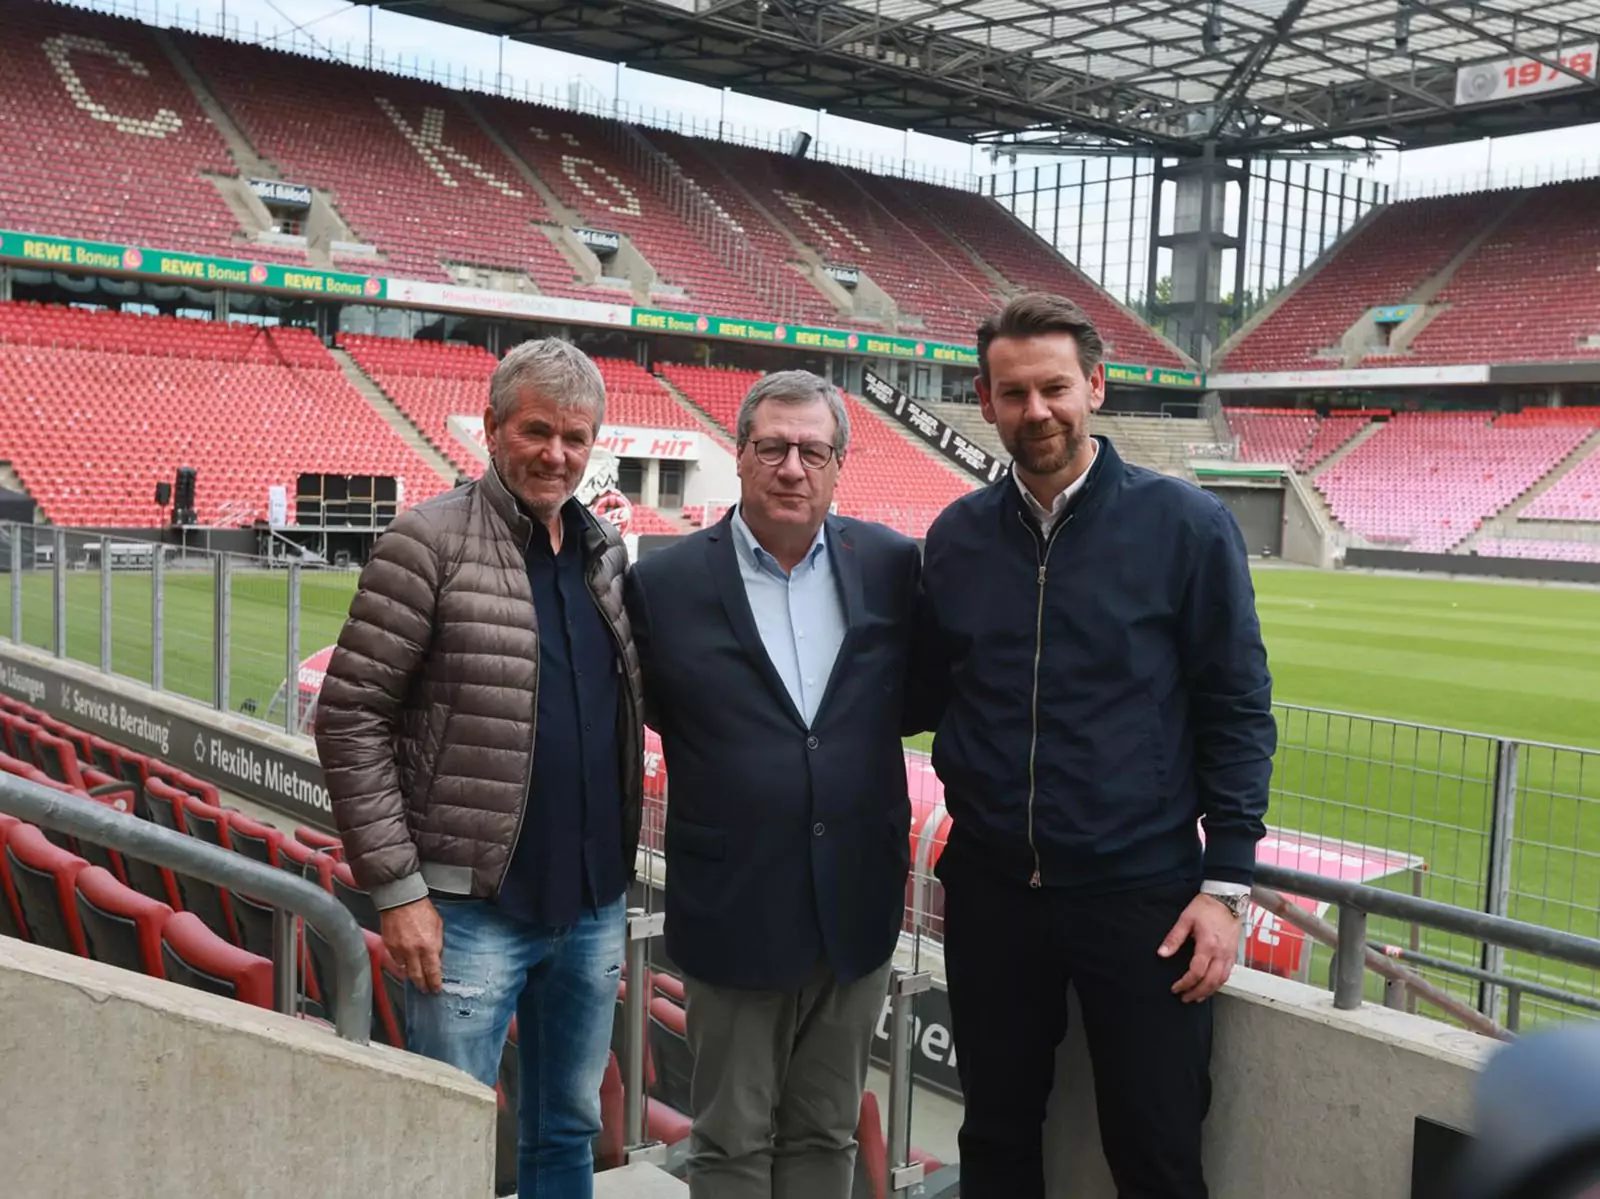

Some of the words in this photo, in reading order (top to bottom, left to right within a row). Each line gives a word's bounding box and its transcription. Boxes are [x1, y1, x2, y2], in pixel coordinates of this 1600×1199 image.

[24, 240, 72, 262] REWE
[76, 247, 119, 269] Bonus
[161, 258, 204, 277] REWE
[208, 264, 247, 281] Bonus
[284, 273, 323, 291] REWE
[327, 277, 361, 296] Bonus
[637, 313, 665, 328] REWE
[719, 323, 747, 337] REWE
[649, 438, 693, 457] HIT
[73, 689, 109, 724] Service
[110, 702, 119, 728] &
[120, 706, 170, 755] Beratung
[210, 738, 262, 785] Flexible
